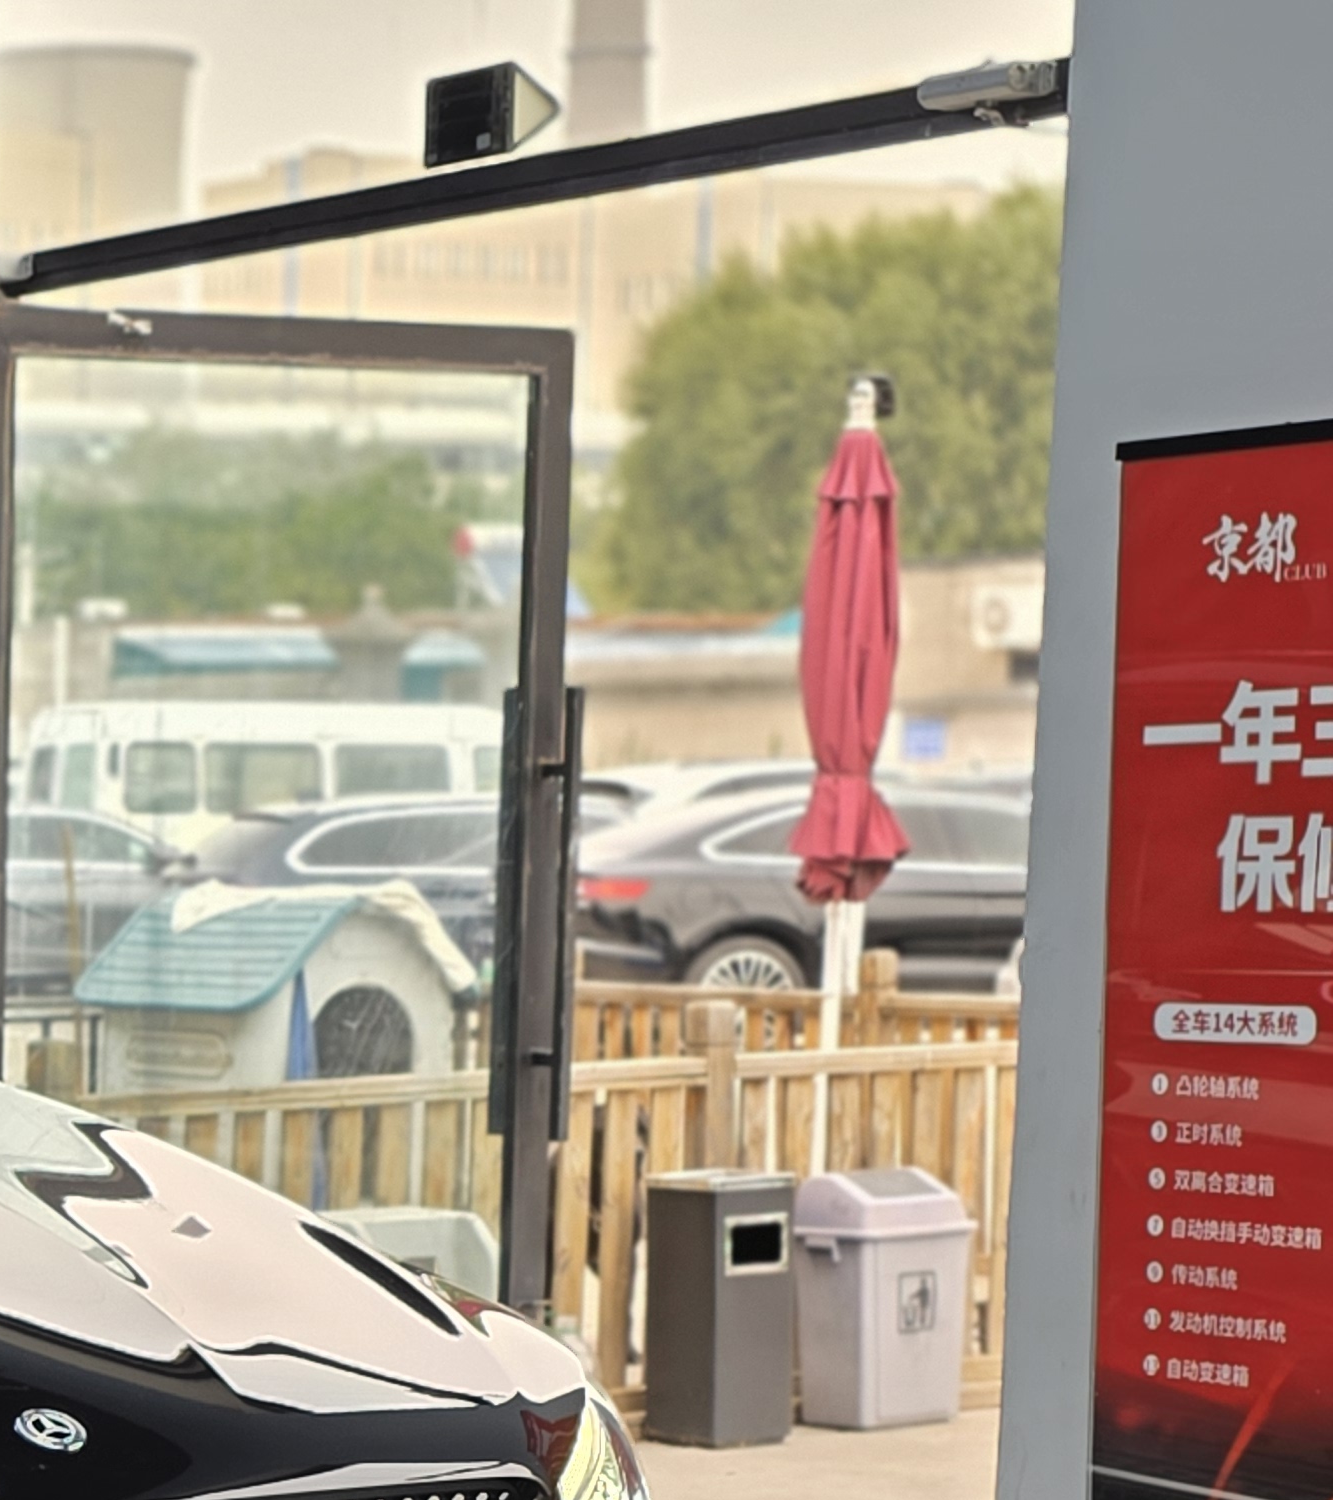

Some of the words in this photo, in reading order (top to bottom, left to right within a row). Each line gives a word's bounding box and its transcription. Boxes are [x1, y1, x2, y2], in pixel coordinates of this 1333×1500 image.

[1201, 511, 1297, 583] 京都
[1283, 562, 1327, 581] CLUB
[1172, 1009, 1299, 1037] 全车14大系统
[1175, 1074, 1260, 1101] 凸轮轴系统
[1175, 1122, 1243, 1147] 正时系统
[1173, 1169, 1275, 1197] 双离合变速箱
[1171, 1263, 1238, 1290] 传动系统
[1169, 1310, 1287, 1344] 发动机控制系统
[1166, 1357, 1250, 1388] 自动变速箱
